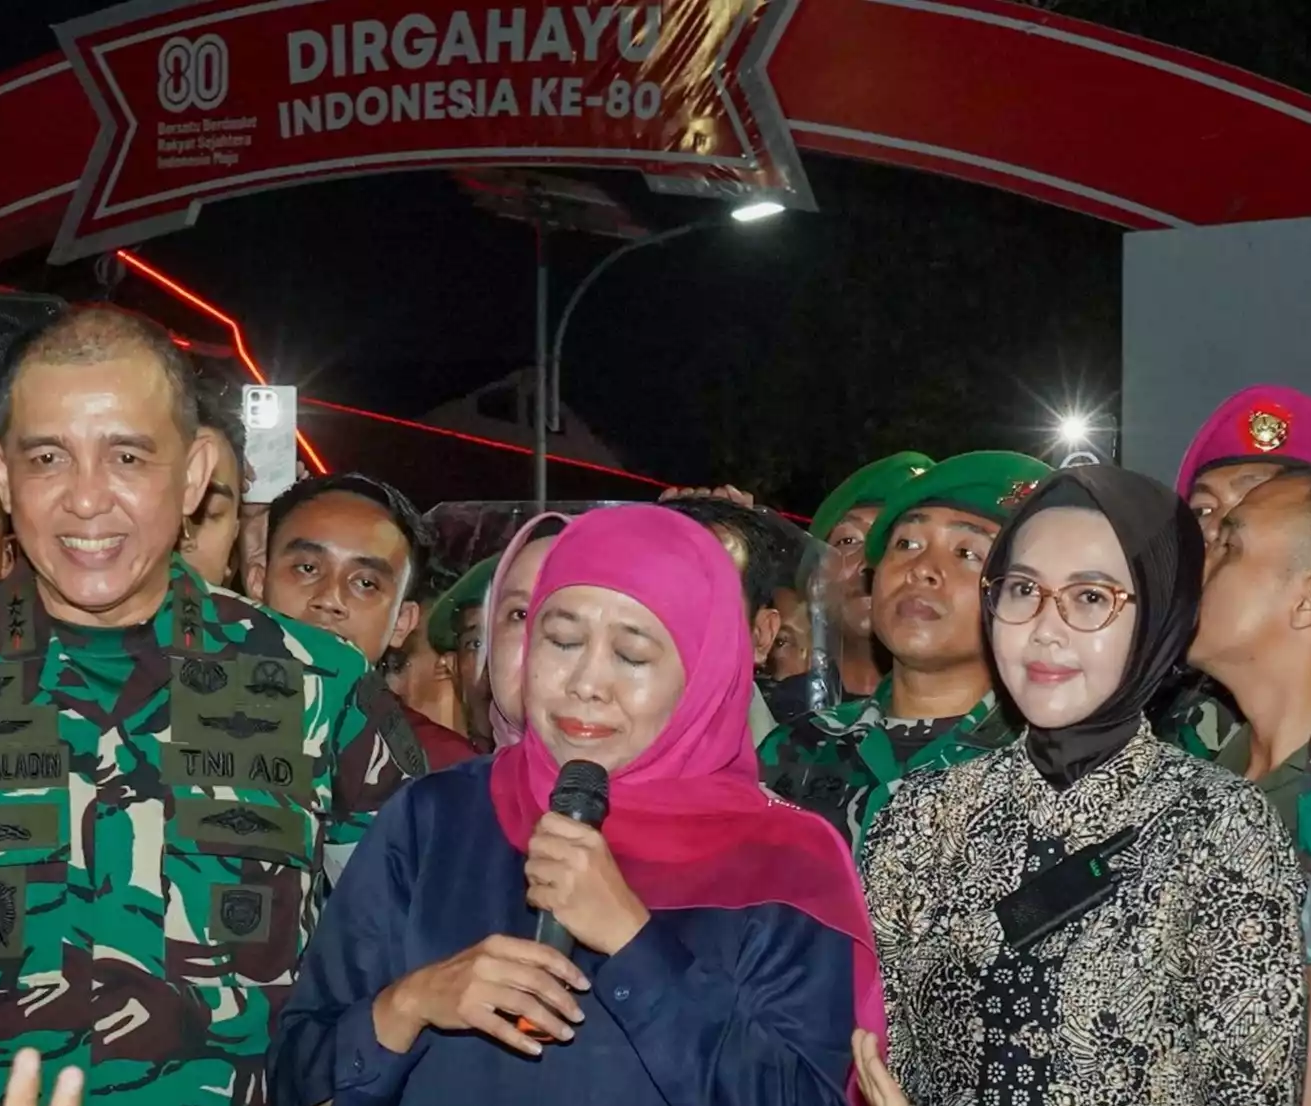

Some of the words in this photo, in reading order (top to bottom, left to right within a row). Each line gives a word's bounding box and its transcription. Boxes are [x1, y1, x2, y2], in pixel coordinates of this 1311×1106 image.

[157, 33, 229, 113] 80
[288, 6, 662, 84] DIRGAHAYU
[278, 78, 520, 139] INDONESIA
[531, 76, 661, 120] KE-80
[179, 749, 235, 777] TNI
[249, 752, 294, 787] AD
